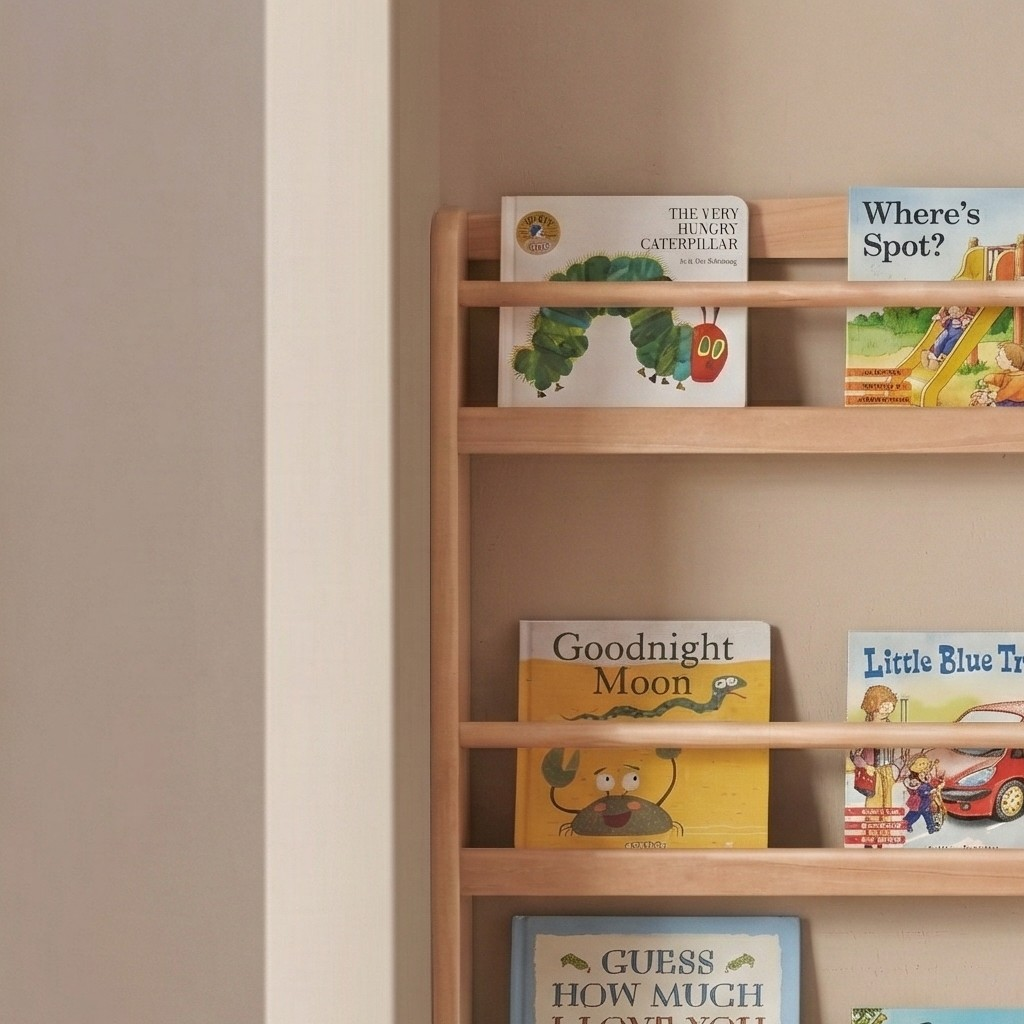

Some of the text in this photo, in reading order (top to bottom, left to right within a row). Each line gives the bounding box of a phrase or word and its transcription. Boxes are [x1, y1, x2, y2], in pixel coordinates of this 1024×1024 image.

[668, 207, 739, 219] THE VERY
[862, 201, 981, 225] Where's
[678, 222, 738, 234] HUNGRY
[640, 238, 738, 250] CATERPILLAR
[863, 233, 945, 262] Spot?
[552, 632, 734, 668] Goodnight
[864, 647, 933, 678] Little
[938, 644, 993, 675] Blue
[593, 666, 692, 695] Moon
[602, 950, 714, 975] GUESS
[552, 983, 764, 1008] HOW MUCH
